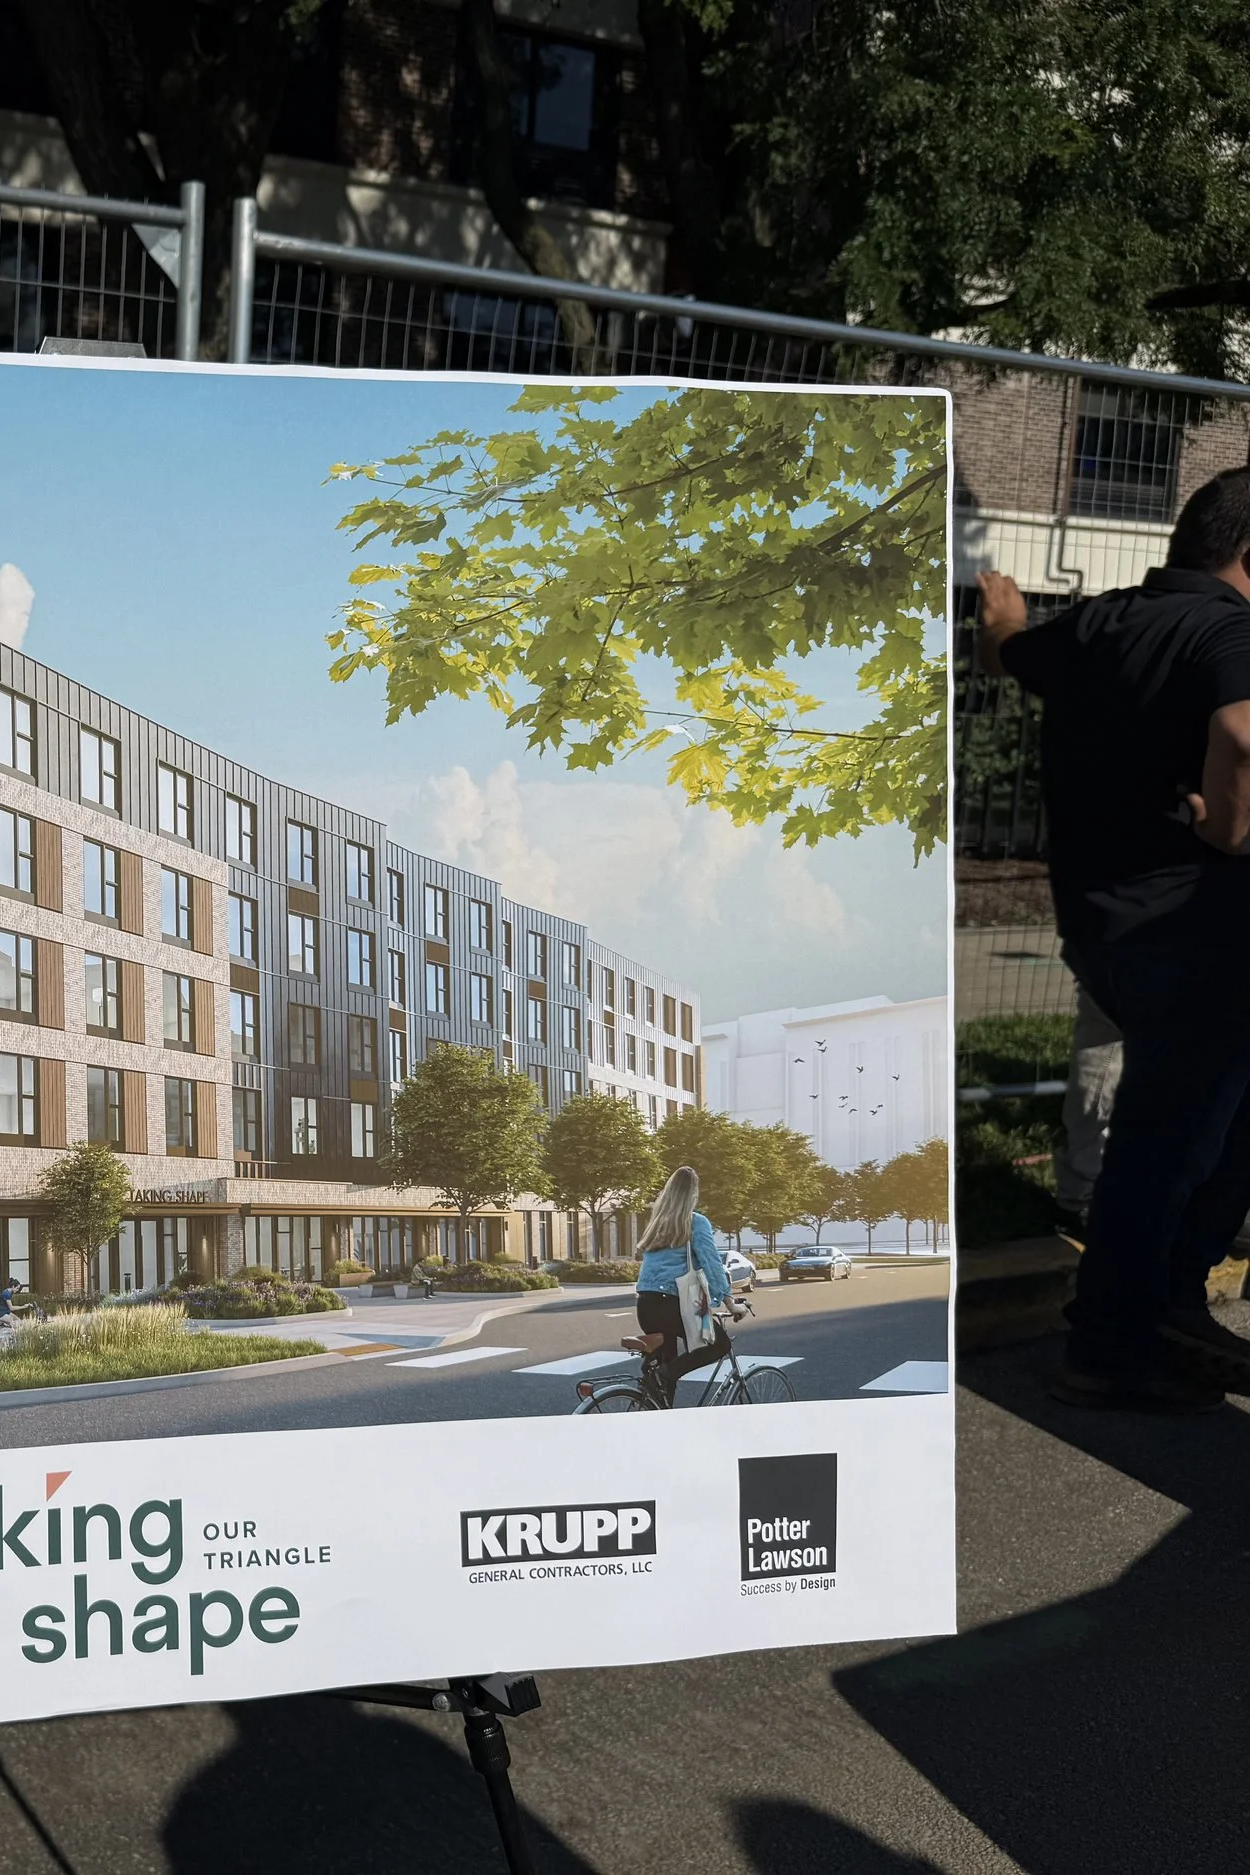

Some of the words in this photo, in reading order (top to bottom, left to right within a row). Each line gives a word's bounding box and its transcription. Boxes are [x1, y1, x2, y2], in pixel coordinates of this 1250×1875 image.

[202, 1520, 258, 1542] OUR
[466, 1507, 652, 1560] KRUPP
[747, 1517, 811, 1544] Potter
[203, 1545, 332, 1570] TRIANGLE
[748, 1546, 828, 1572] Lawson
[469, 1569, 525, 1584] GENERAL
[529, 1563, 628, 1579] CONTRACTORS,
[632, 1561, 652, 1574] LLC
[740, 1582, 782, 1597] Success
[785, 1580, 797, 1593] by
[800, 1577, 836, 1591] Design
[21, 1574, 301, 1676] shape
